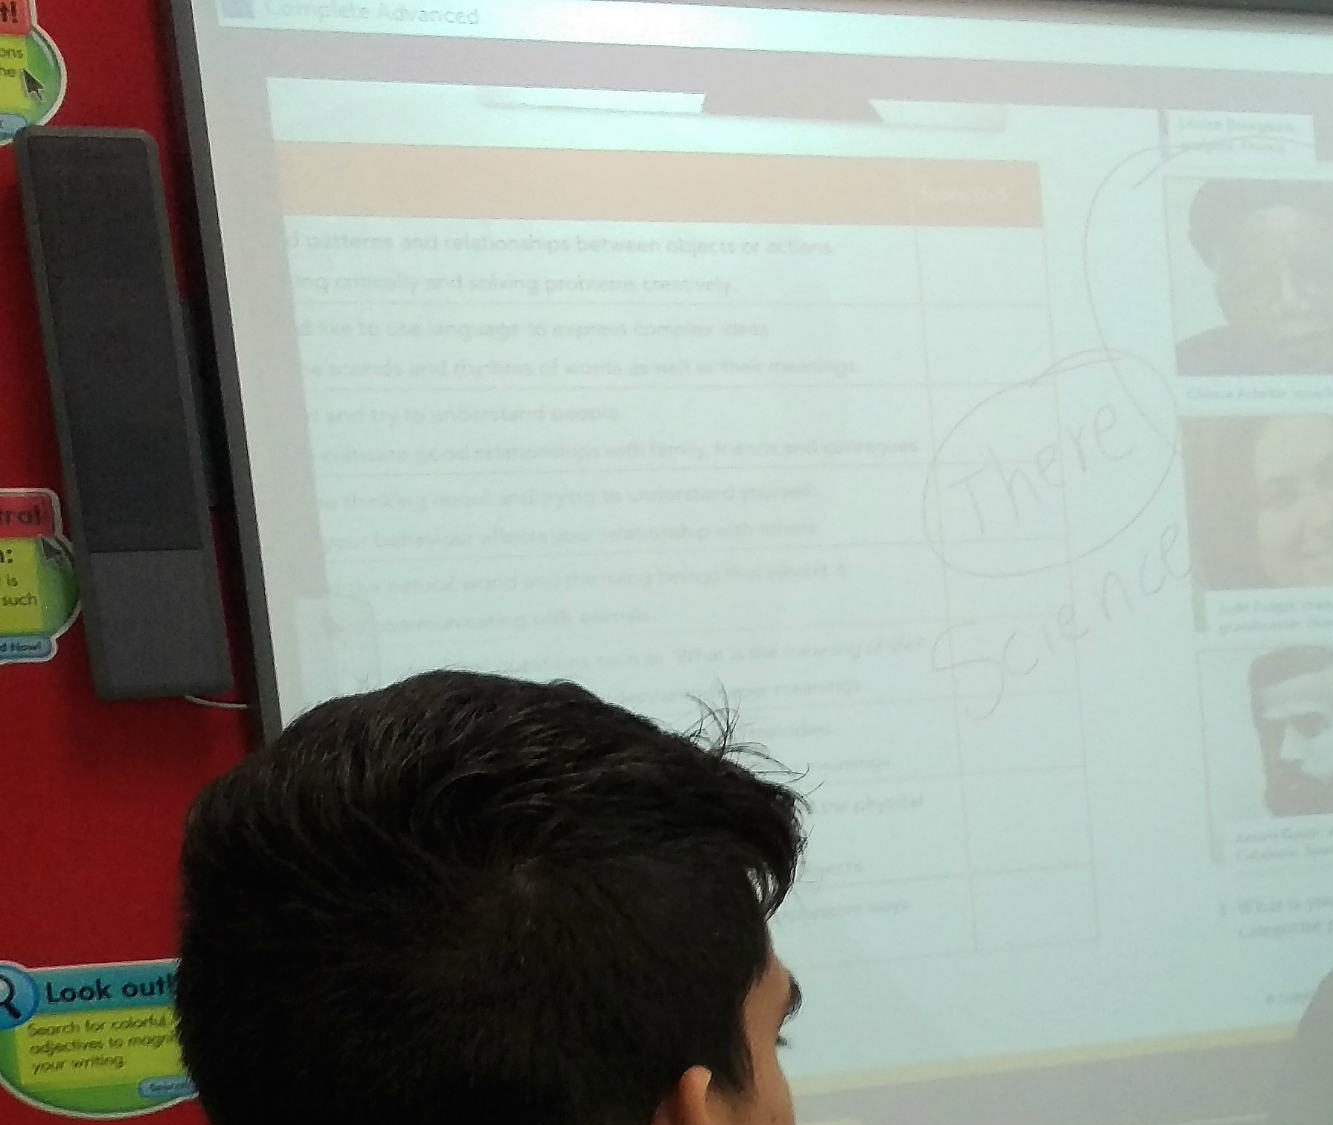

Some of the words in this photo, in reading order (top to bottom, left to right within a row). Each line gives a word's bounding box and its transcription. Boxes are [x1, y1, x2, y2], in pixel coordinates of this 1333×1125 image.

[376, 3, 480, 26] Advanced
[946, 403, 1134, 538] There
[931, 522, 1193, 721] Science
[46, 977, 114, 1004] Look
[121, 973, 175, 999] out!
[27, 1021, 81, 1038] Search
[85, 1018, 106, 1033] for
[29, 1038, 104, 1058] adjectives
[108, 1036, 123, 1048] to
[32, 1058, 67, 1076] your
